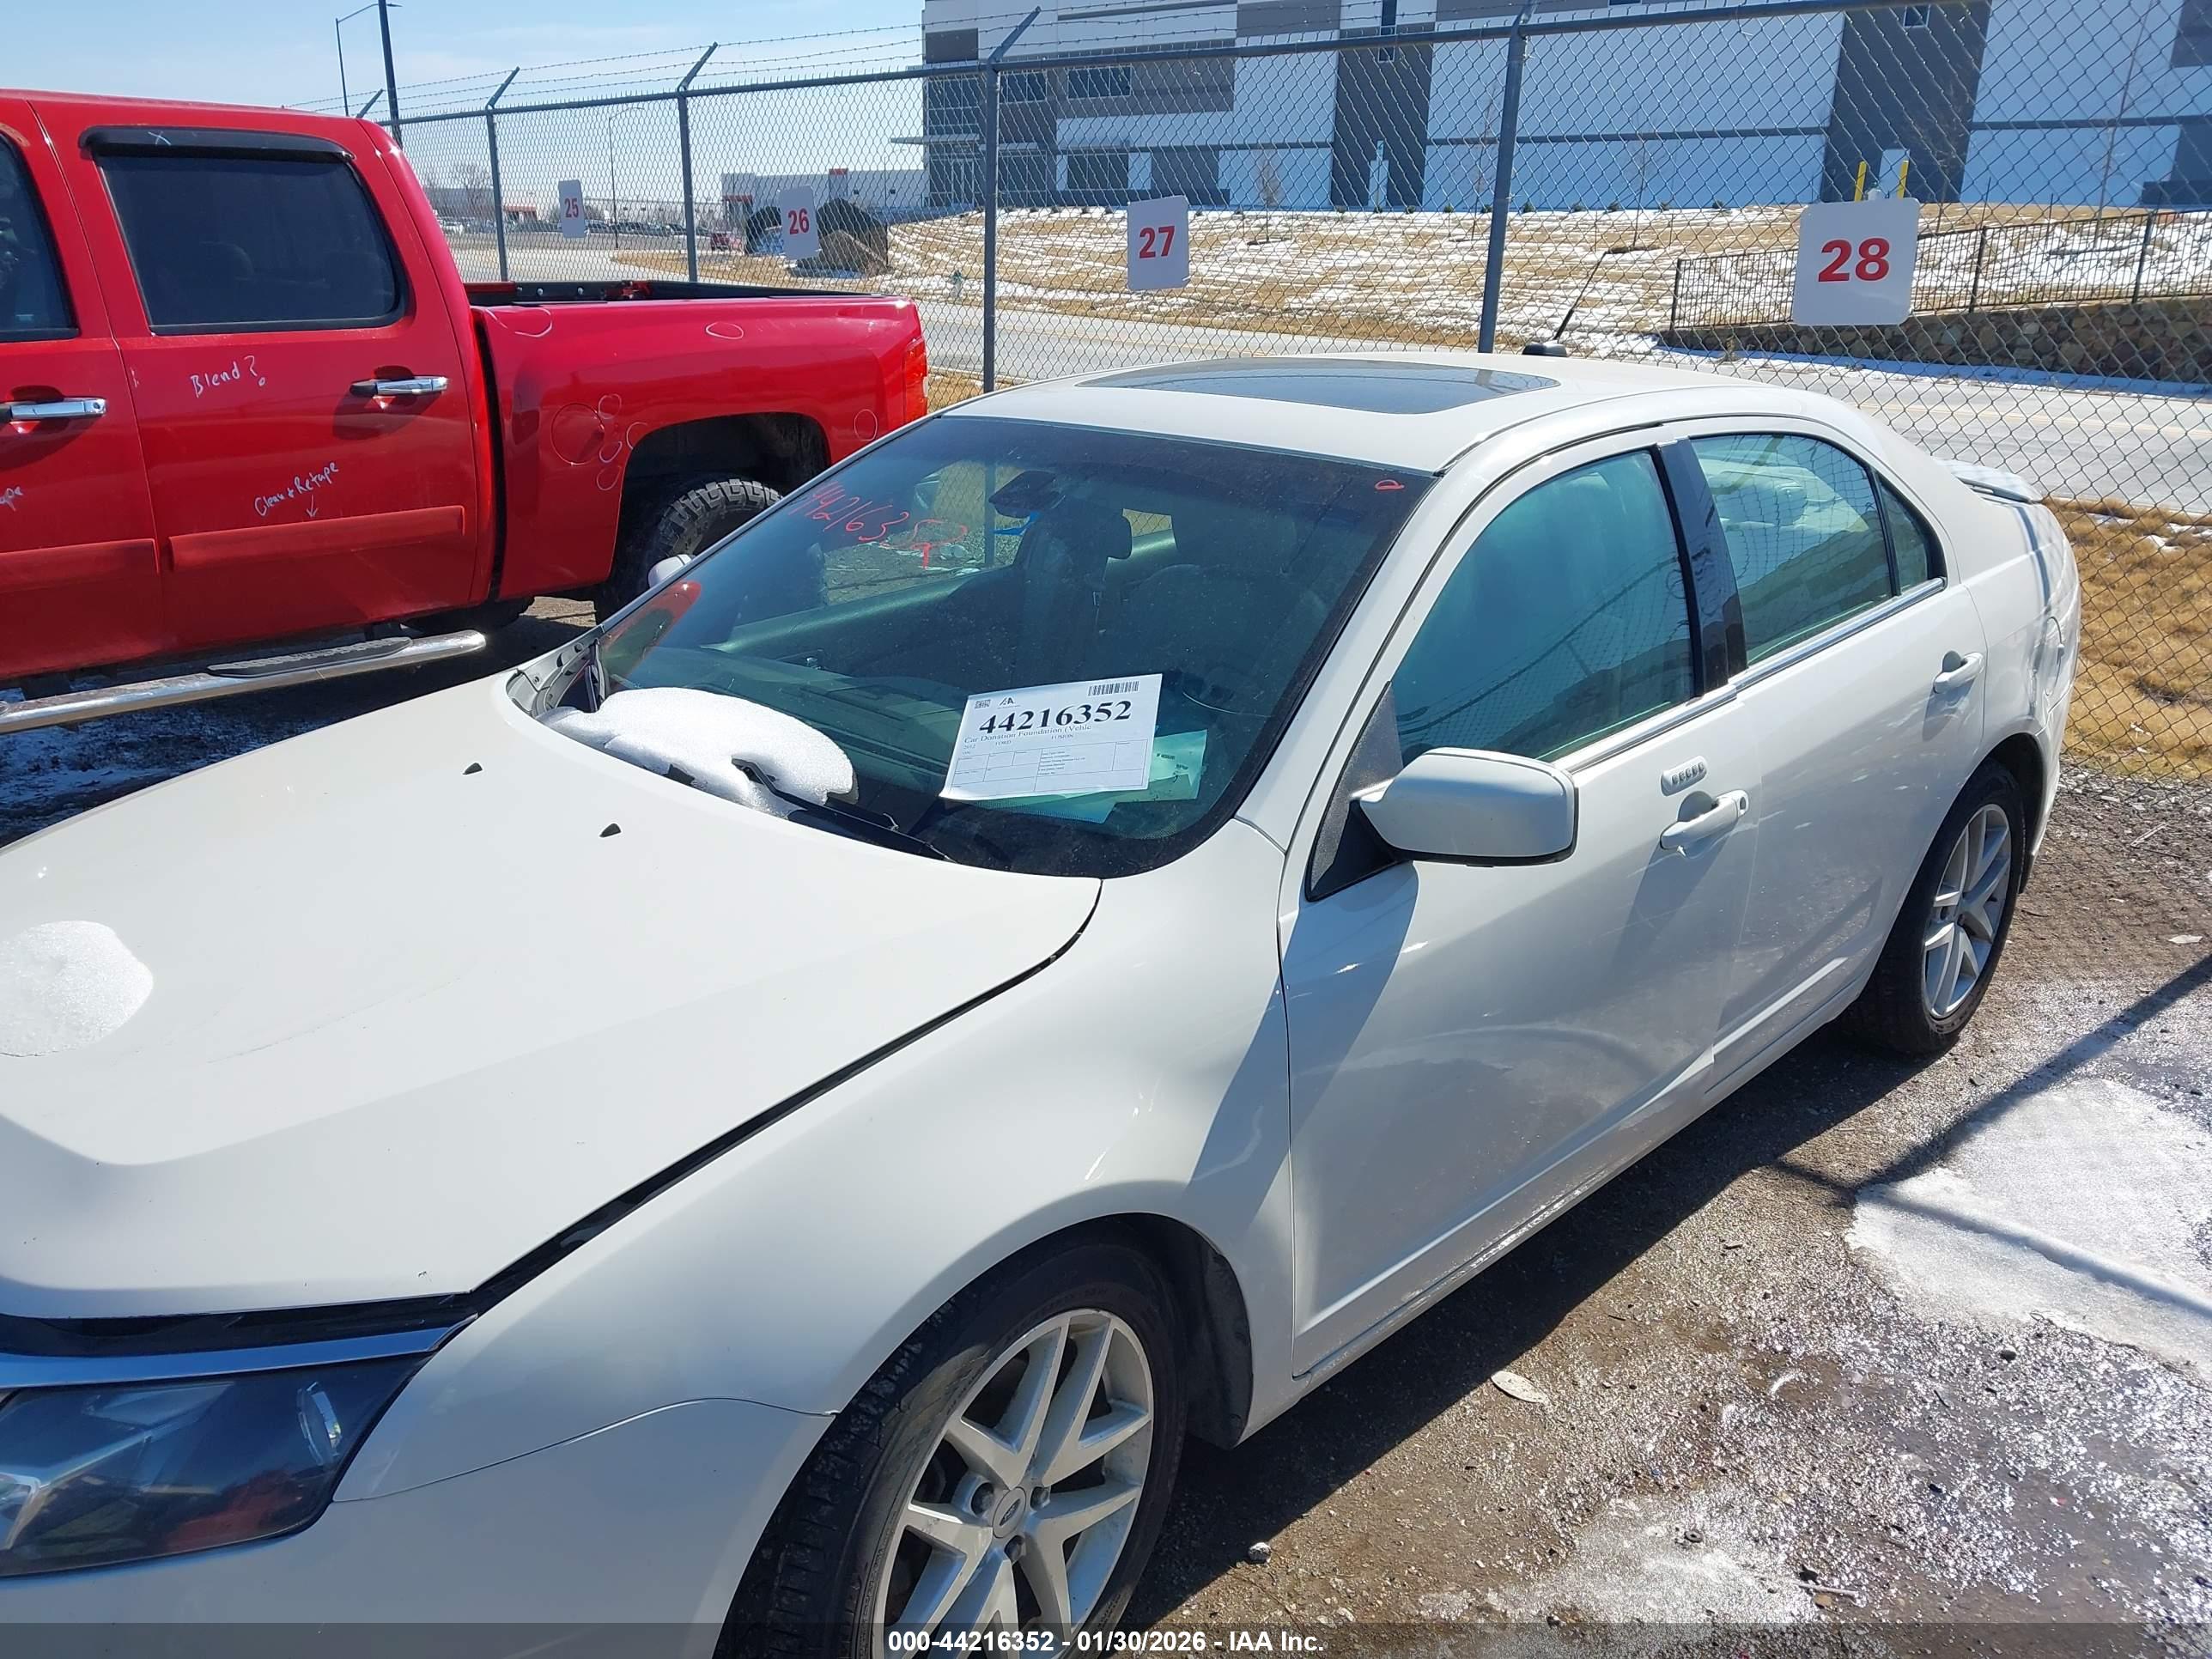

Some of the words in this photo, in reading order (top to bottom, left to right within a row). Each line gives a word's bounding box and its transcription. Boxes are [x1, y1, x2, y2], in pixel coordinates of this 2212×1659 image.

[564, 198, 579, 218] 25
[787, 208, 810, 234] 26
[1139, 225, 1176, 258] 27
[1818, 237, 1890, 282] 28
[979, 701, 1132, 733] 44216352
[981, 733, 1016, 742] Donation
[1018, 726, 1063, 737] Foundation
